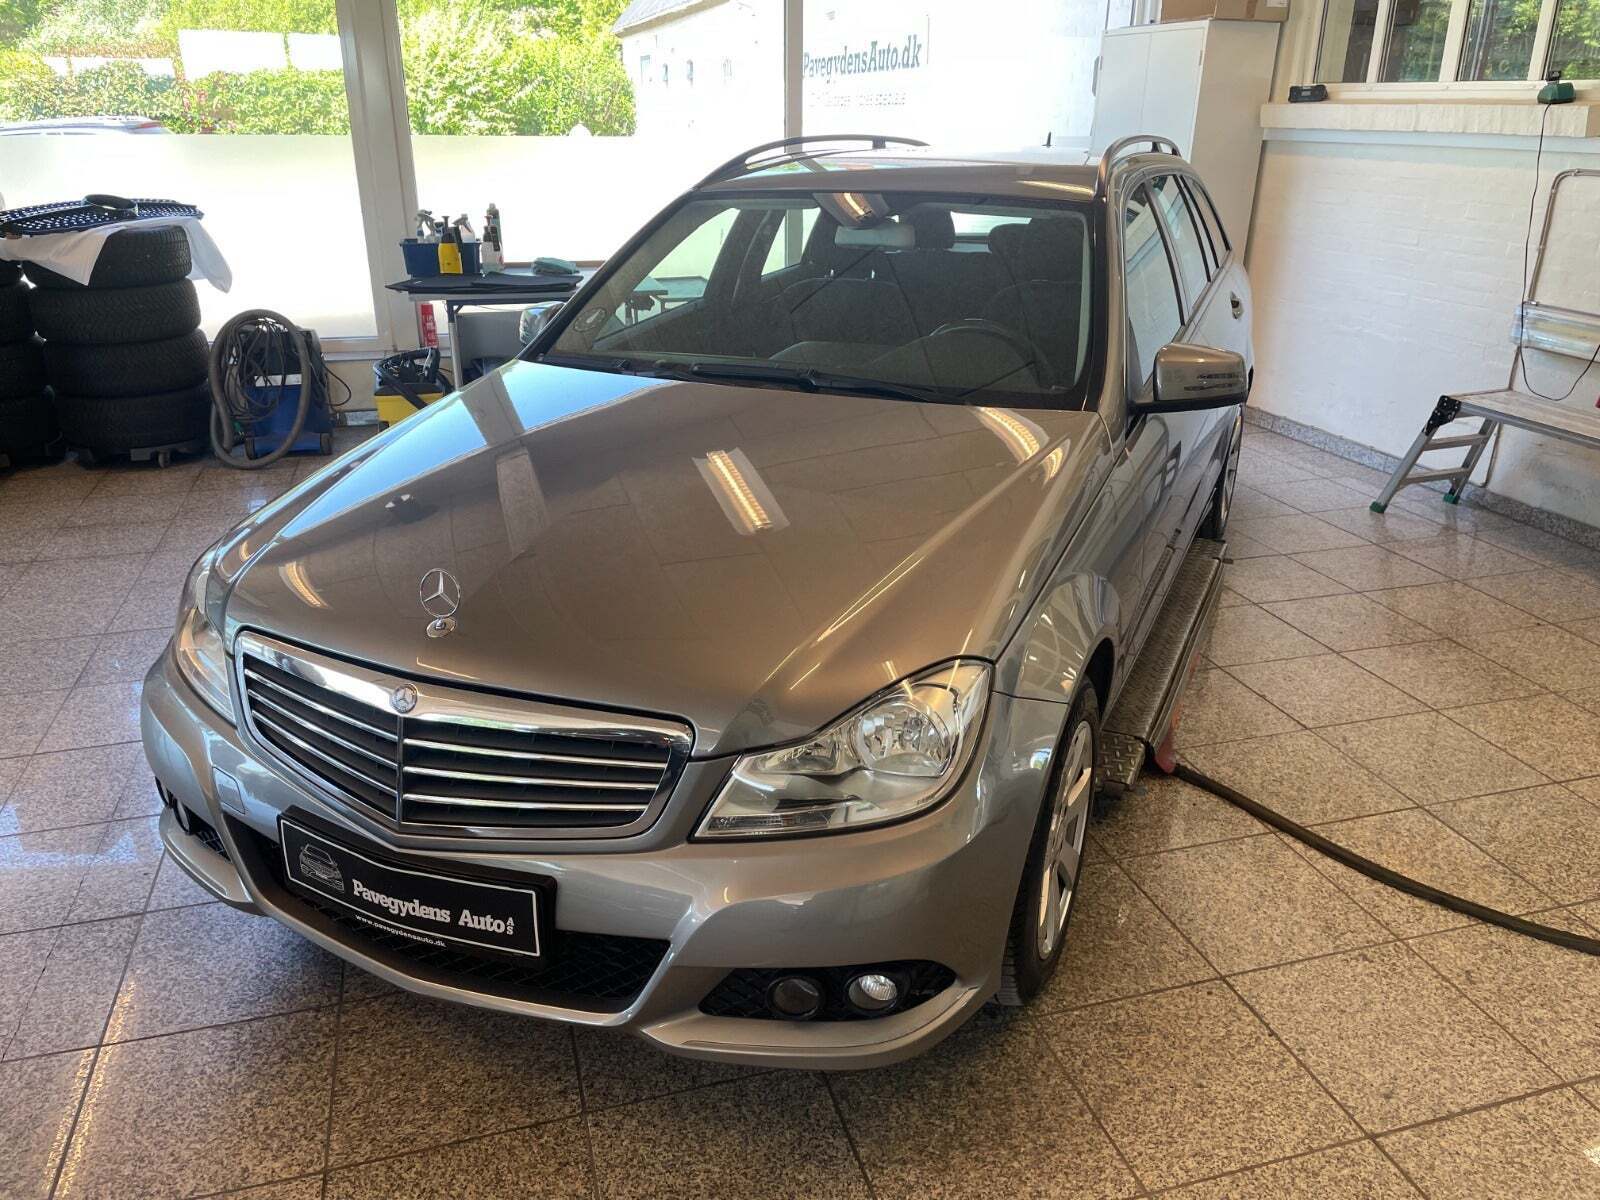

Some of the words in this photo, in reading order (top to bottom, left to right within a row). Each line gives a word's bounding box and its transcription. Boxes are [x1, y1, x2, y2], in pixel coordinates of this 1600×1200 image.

[352, 879, 451, 922] Pavegydens
[458, 909, 505, 933] Auto
[355, 914, 448, 948] www.pavegydensauto.dk
